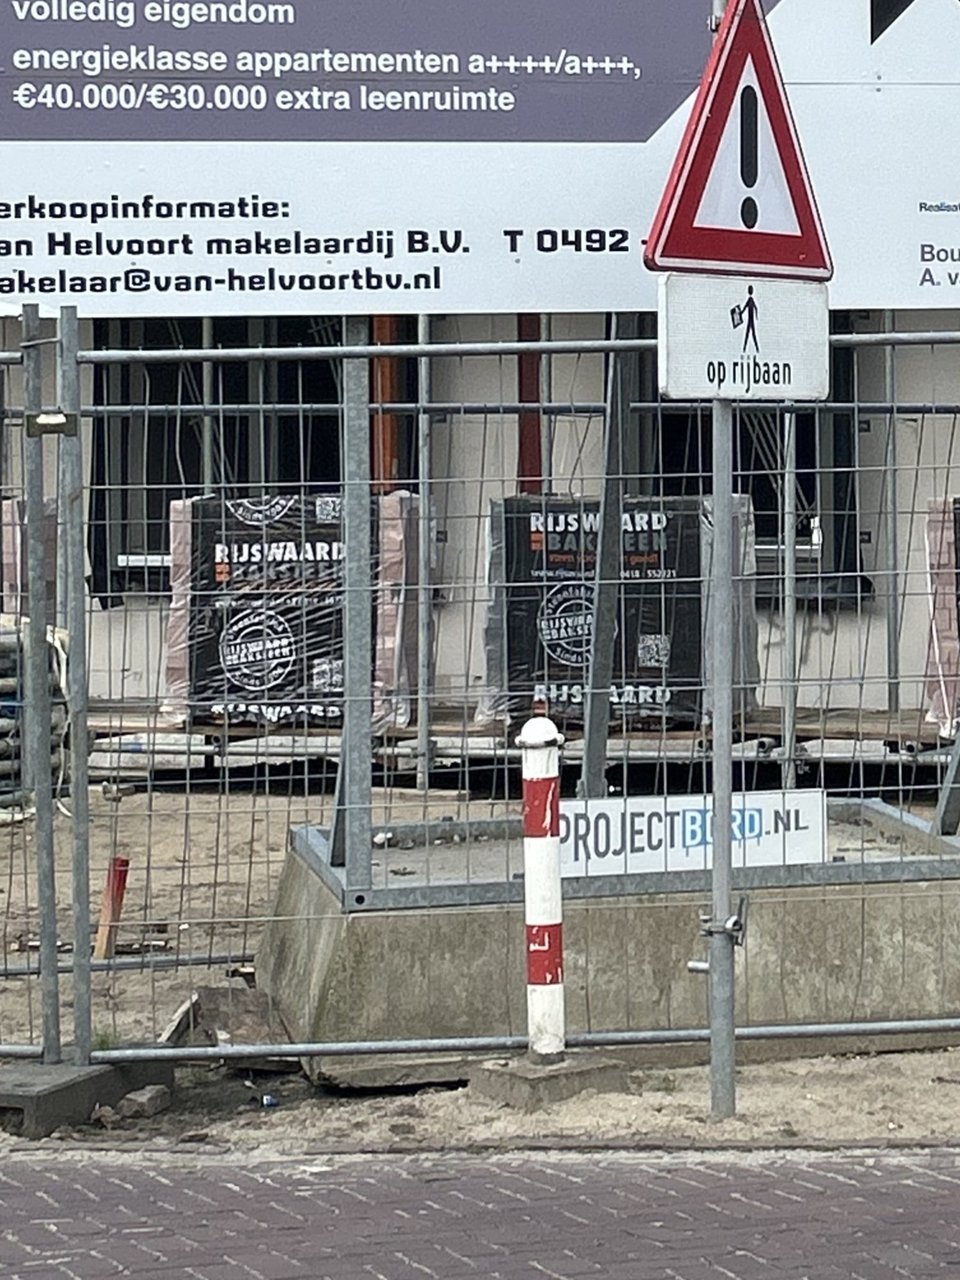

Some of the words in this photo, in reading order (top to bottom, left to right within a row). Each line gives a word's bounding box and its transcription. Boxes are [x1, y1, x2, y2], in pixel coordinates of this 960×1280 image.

[12, 44, 228, 76] energieklasse
[236, 48, 459, 78] appartementen
[468, 48, 641, 80] a++++/a+++,
[12, 82, 268, 110] €40.000/€30.000
[275, 87, 351, 110] extra
[360, 85, 516, 111] leenruimte
[48, 231, 194, 256] Helvoort
[206, 230, 394, 259] makelaardij
[407, 230, 470, 254] B.V.
[503, 229, 524, 253] T
[536, 229, 630, 253] 0492
[919, 267, 941, 287] A.
[707, 360, 726, 390] op
[732, 354, 792, 393] rijbaan
[530, 511, 668, 532] RIJSWARD
[548, 532, 667, 552] BAKEEN
[533, 684, 671, 704] RIJSAARD
